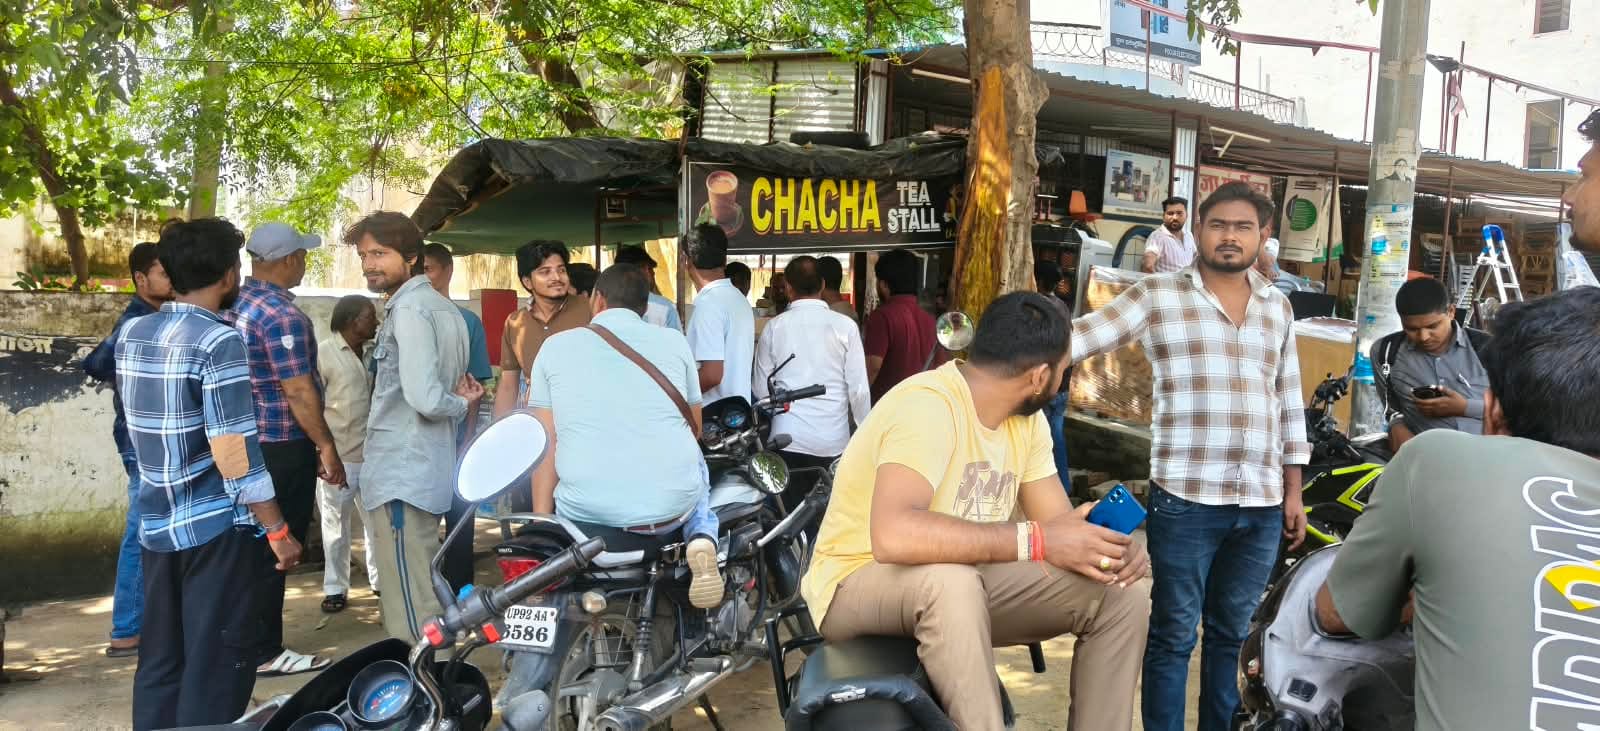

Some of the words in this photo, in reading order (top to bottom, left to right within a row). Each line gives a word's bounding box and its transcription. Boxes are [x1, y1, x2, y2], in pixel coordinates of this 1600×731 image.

[751, 177, 882, 234] CHACHA
[896, 181, 930, 206] TEA
[887, 208, 941, 233] STALL
[506, 608, 533, 621] UP92
[533, 610, 548, 622] AA
